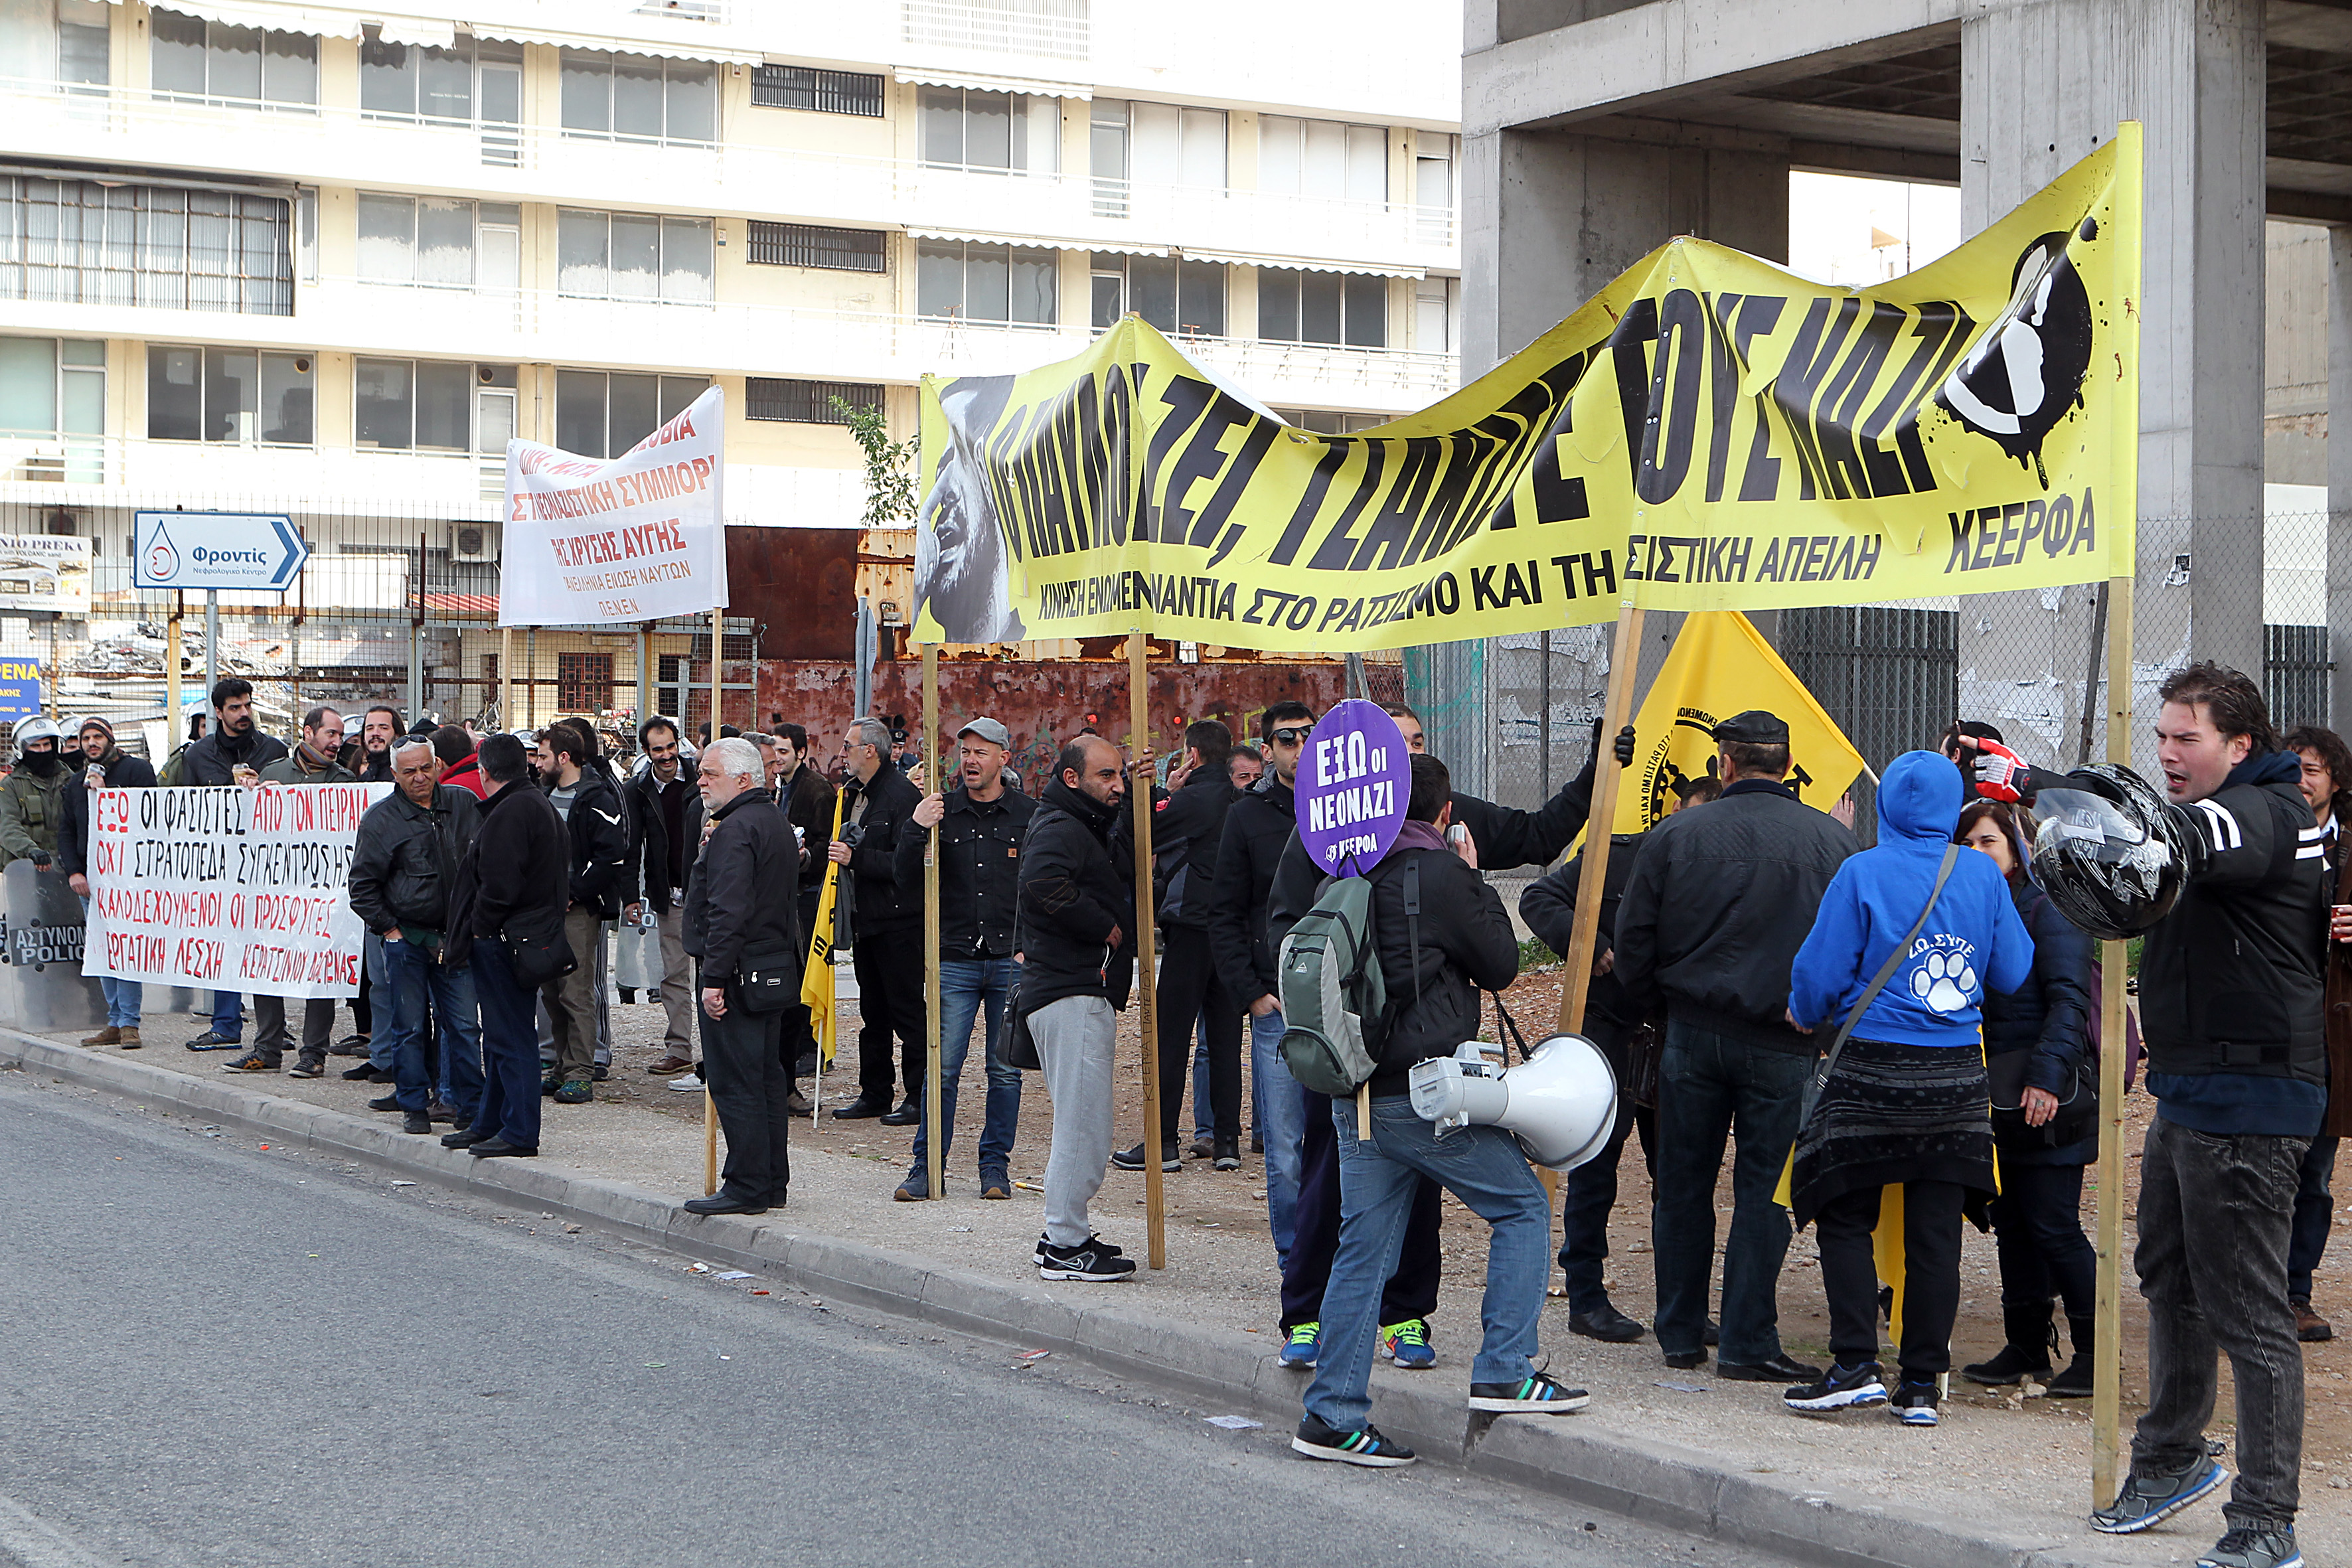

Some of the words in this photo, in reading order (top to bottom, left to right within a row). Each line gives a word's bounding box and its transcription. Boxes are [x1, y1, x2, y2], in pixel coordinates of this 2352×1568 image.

[1774, 297, 1977, 500] ΝΑΖΙ
[550, 538, 572, 567] ΤΗΣ
[568, 531, 623, 566] ΧΡΥΣΗΣ
[623, 518, 687, 559] ΑΥΓΗΣ
[1944, 487, 2096, 574] ΚΕΕΡΦΑ
[192, 546, 267, 566] Φροντίς
[193, 566, 240, 576] Νεφρολογικό
[242, 566, 267, 576] Κέντρο
[605, 569, 639, 589] ΕΝΩΣΗ
[639, 560, 692, 585] ΝΑΥΤΩΝ
[1038, 579, 1086, 620] ΚΙΝΗΣΗ
[1243, 589, 1317, 631] ΣΤΟ
[1470, 560, 1543, 612] ΚΑΙ
[1551, 549, 1618, 599] ΤΗ
[1755, 534, 1881, 584] ΑΠΕΙΛΗ
[0, 663, 40, 680] ΕΝΑ
[1316, 730, 1368, 787] ΕΞΩ
[98, 791, 129, 832] ΕΞΩ
[141, 790, 157, 830] ΟΙ
[165, 788, 246, 836] ΦΑΣΙΣΤΕΣ
[252, 788, 283, 834] ΑΠΟ
[287, 788, 314, 834] ΤΟΝ
[1309, 780, 1394, 832] ΝΕΟΝΑΖΙ
[96, 840, 124, 876] ΟΧΙ
[135, 839, 226, 882] ΣΤΡΑΤΟΠΕΔΑ
[238, 842, 353, 890] ΣΥΓΚΕΝΤΡΩΣΗΣ
[97, 887, 222, 929] ΚΑΛΟΔΕΧΟΥΜΕΝΟΙ
[230, 893, 246, 931] ΟΙ
[254, 894, 337, 939] ΠΡΟΣΦΥΓΕΣ
[106, 932, 166, 974] ΕΡΓΑΤΙΚΗ
[175, 937, 224, 980] ΛΕΣΧΗ
